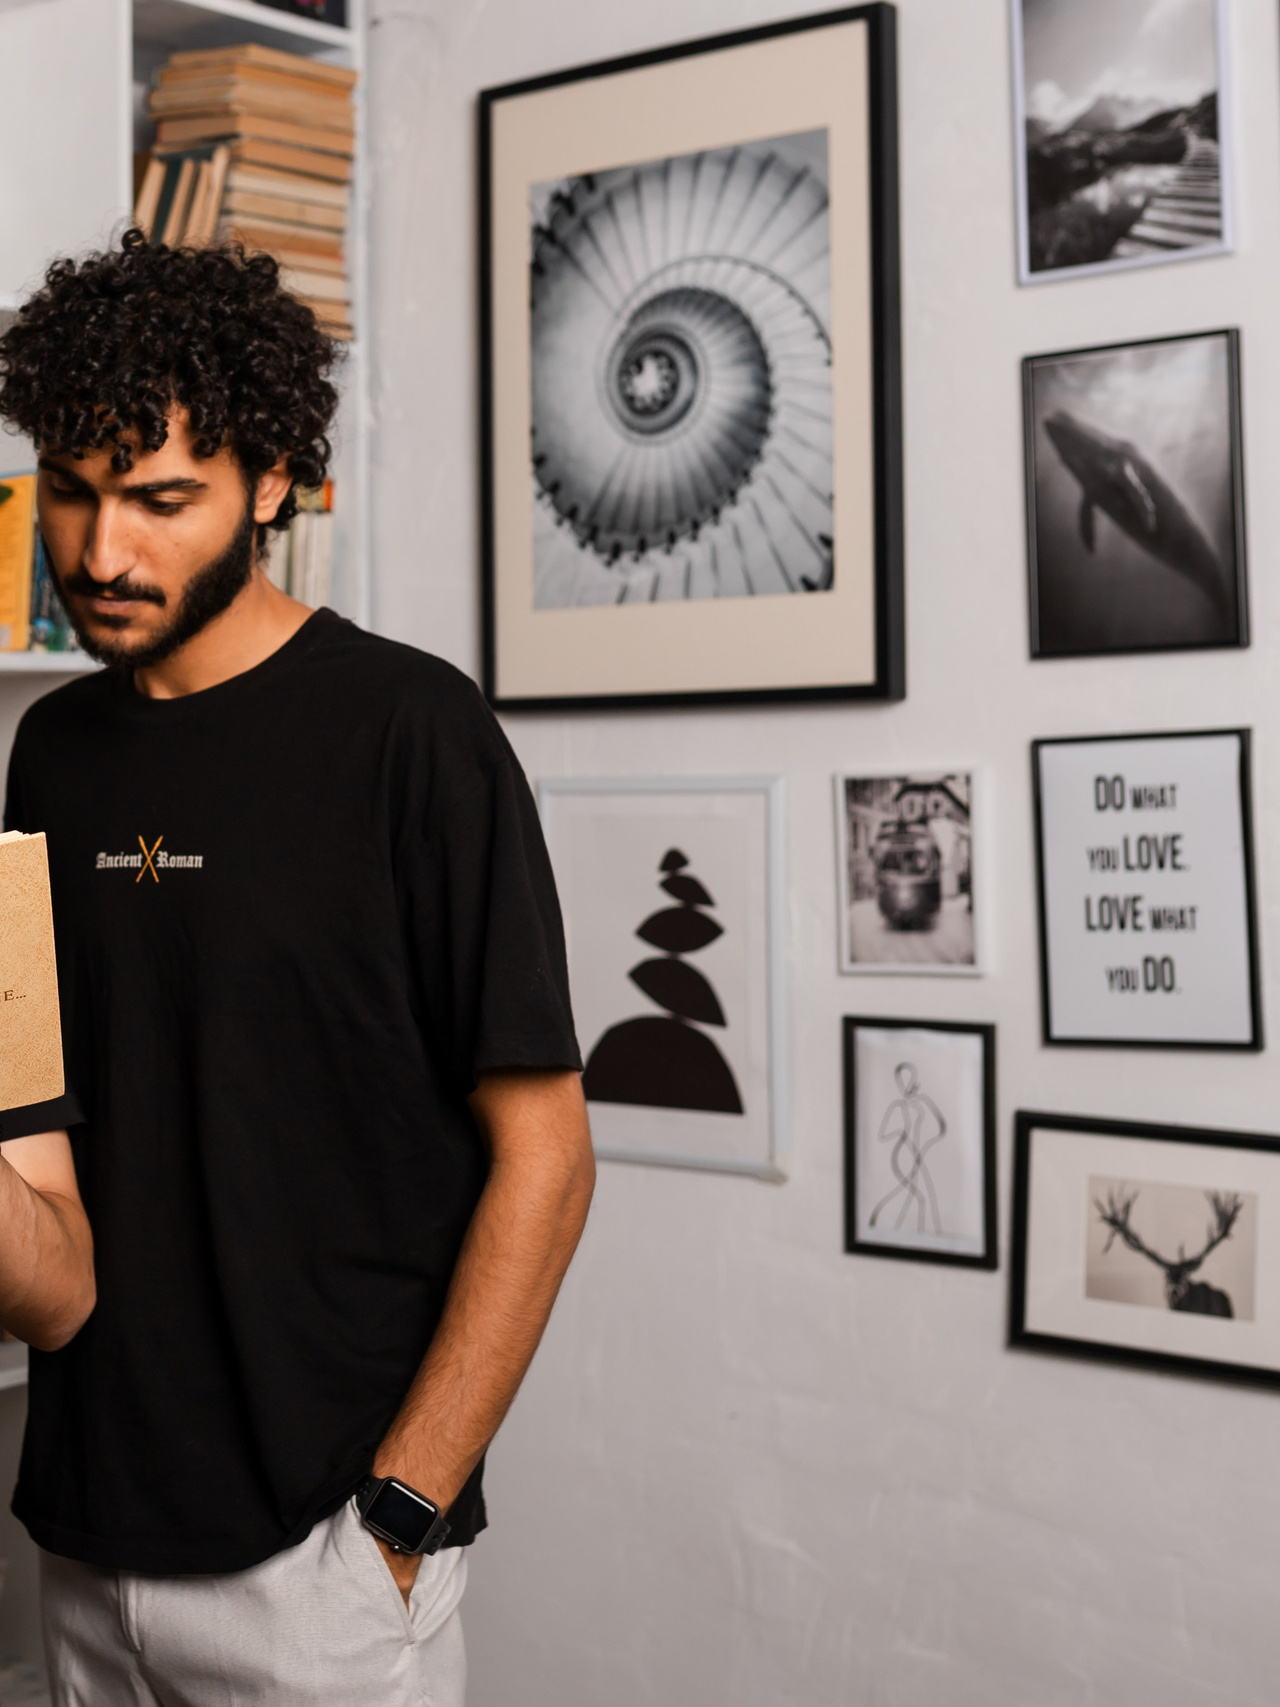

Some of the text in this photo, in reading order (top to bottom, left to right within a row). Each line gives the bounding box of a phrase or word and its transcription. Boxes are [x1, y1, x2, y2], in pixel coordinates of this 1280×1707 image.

[1094, 774, 1179, 812] DO WHAT
[96, 852, 142, 869] Ancient
[157, 851, 204, 868] Roman
[1086, 847, 1119, 872] YOU
[1084, 894, 1198, 932] LOVE WHAT
[1105, 966, 1139, 993] YOU
